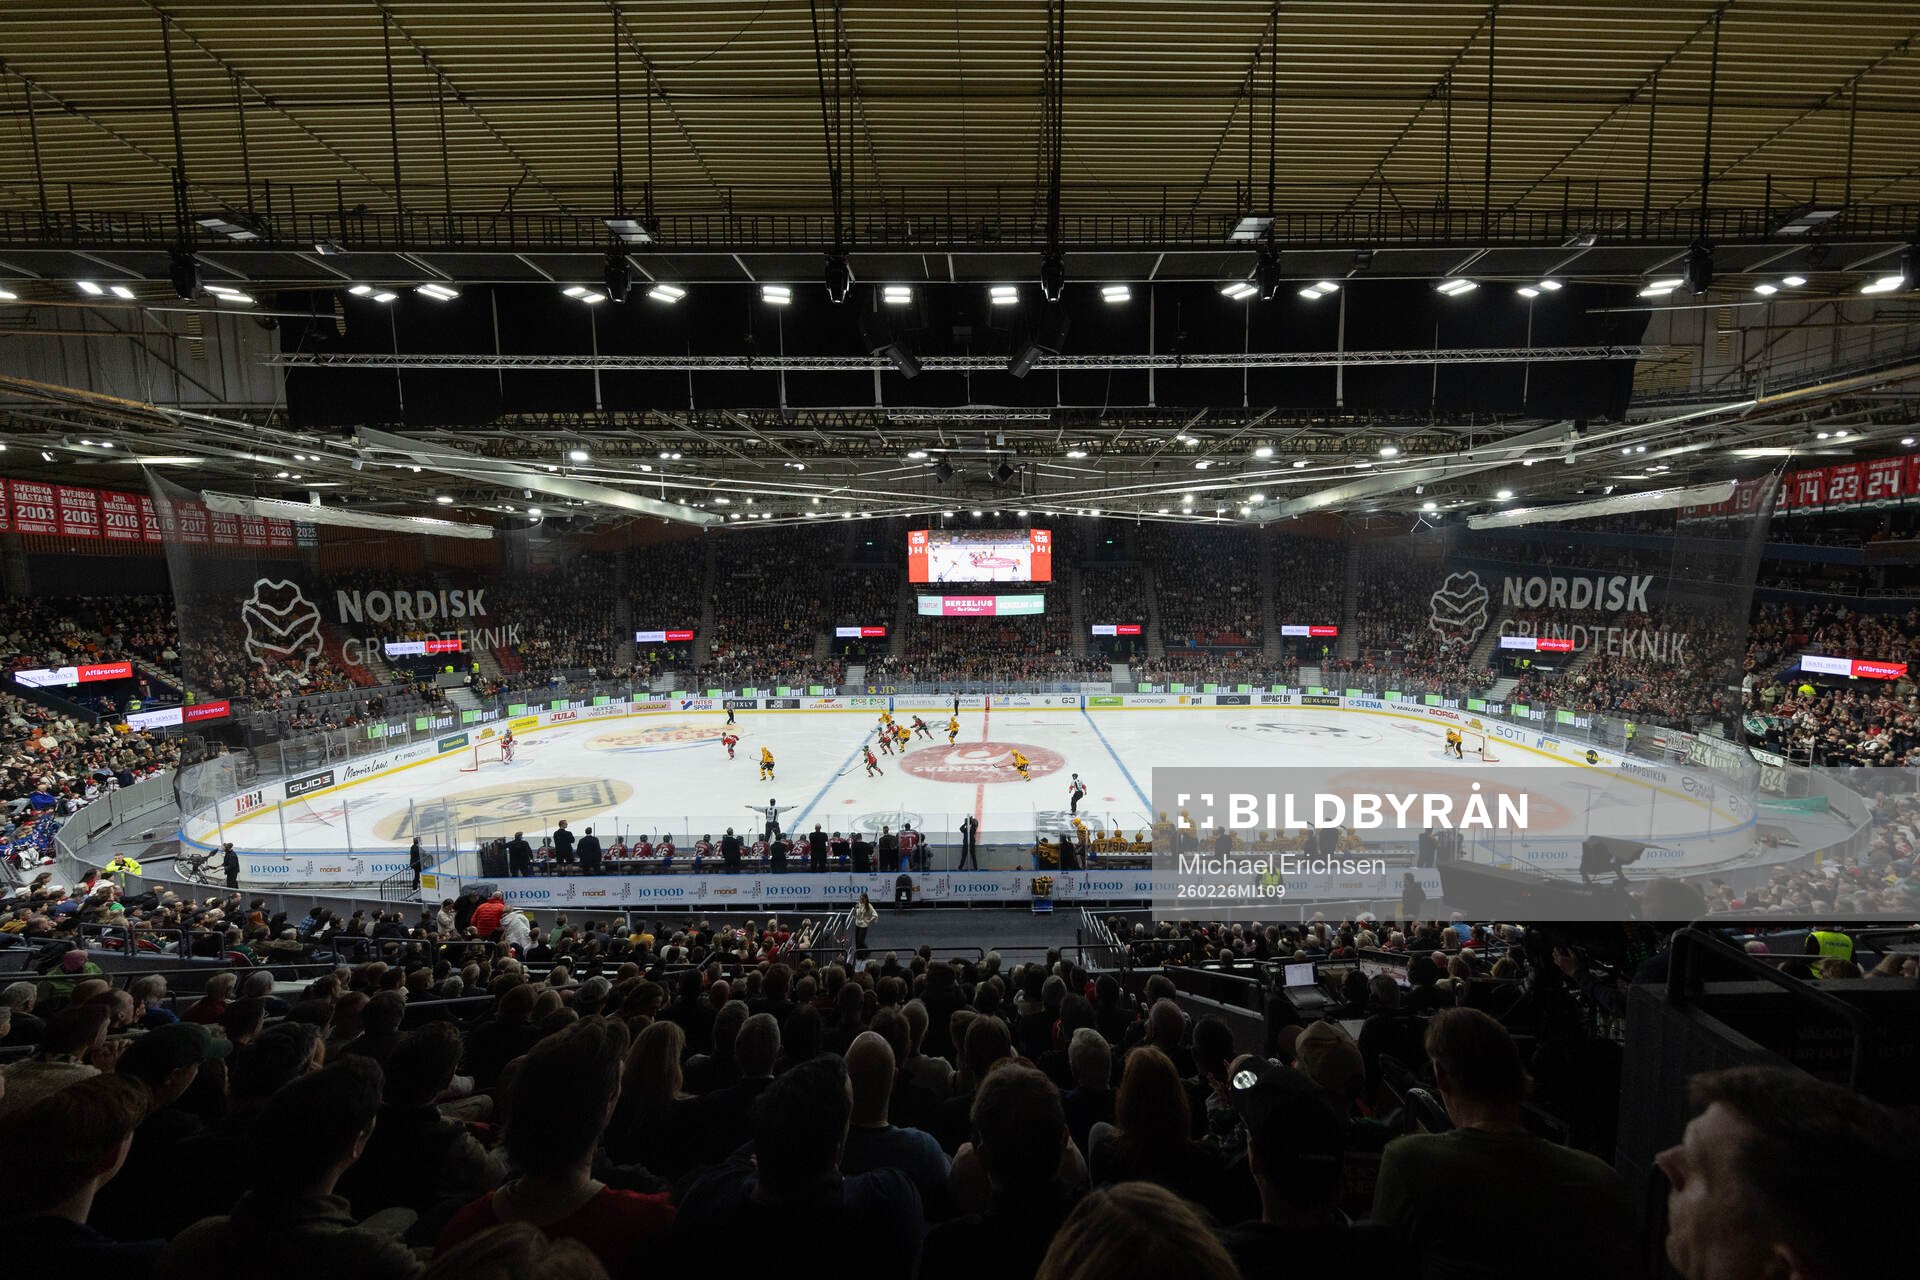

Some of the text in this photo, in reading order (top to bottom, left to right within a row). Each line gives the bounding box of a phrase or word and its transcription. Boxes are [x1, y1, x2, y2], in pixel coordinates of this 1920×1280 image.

[1829, 475, 1859, 499] 23
[1867, 470, 1900, 496] 24
[13, 484, 52, 494] SVENSKA
[60, 488, 96, 500] SVENSKA
[1800, 480, 1819, 503] 14
[16, 505, 55, 519] 2003
[62, 510, 98, 524] 2005
[106, 513, 138, 528] 2016
[181, 520, 206, 532] 2017
[213, 522, 238, 534] 2019
[243, 524, 266, 536] 2019
[270, 526, 292, 537] 2020
[297, 526, 317, 538] 2025
[1503, 575, 1654, 612] NORDISK
[336, 589, 487, 623] NORDISK
[343, 622, 521, 665] GRUNDTEKNIK
[85, 666, 126, 677] Affärsresor
[1261, 695, 1291, 703] IMPACT BY
[1356, 700, 1382, 709] STENA
[188, 705, 225, 717] Affärsresor
[551, 711, 577, 722] JULA
[1429, 709, 1460, 720] BORGA
[1496, 725, 1526, 742] SOTI
[344, 765, 371, 781] Morris
[913, 764, 1051, 772] SVENSKA SEL
[1621, 762, 1667, 783] SKEPPSVIKEN
[289, 774, 333, 794] GUIDE
[1112, 842, 1125, 851] 96
[1528, 851, 1568, 860] JO FOOD
[250, 865, 289, 873] JO FOOD
[371, 863, 382, 872] JO
[766, 886, 811, 896] JO FOOD
[824, 885, 868, 895] JO FOOD
[954, 884, 999, 893] JO FOOD
[1079, 881, 1123, 891] JO FOOD
[1135, 882, 1179, 891] JO FOOD
[1281, 881, 1308, 890] OOD
[505, 890, 550, 899] JO FOOD
[639, 888, 684, 897] JO FOOD
